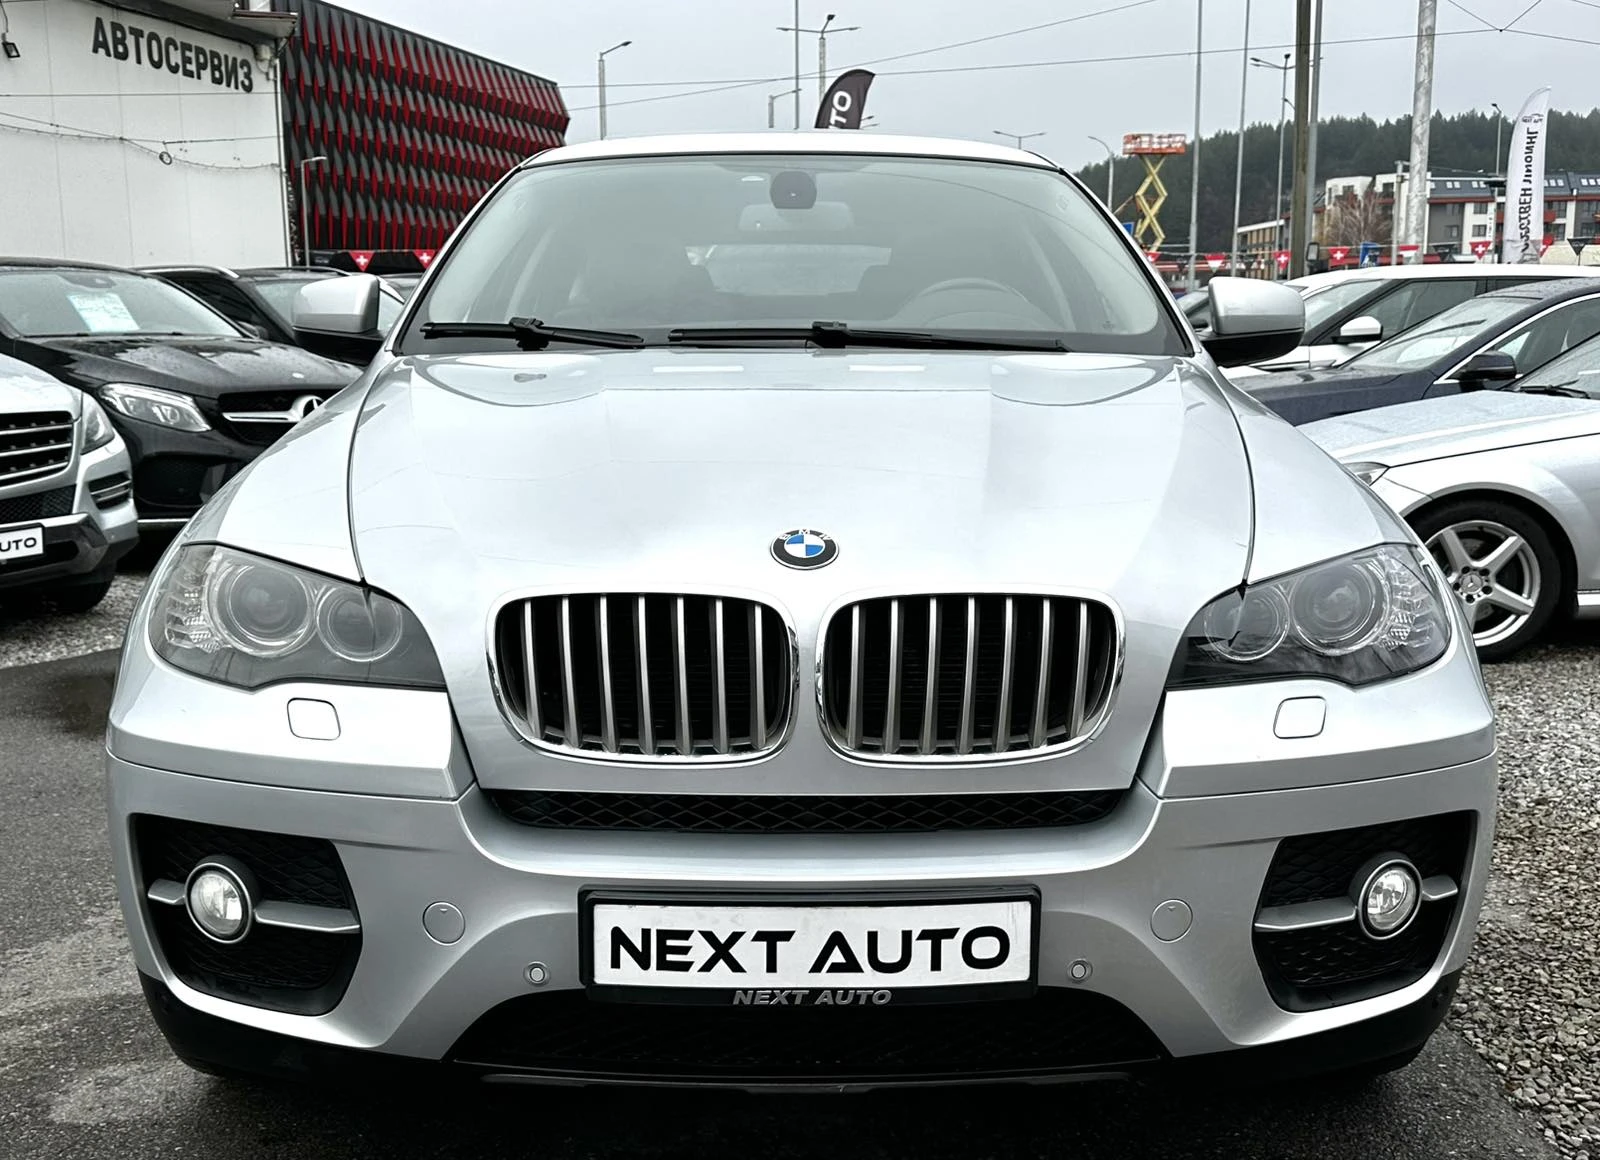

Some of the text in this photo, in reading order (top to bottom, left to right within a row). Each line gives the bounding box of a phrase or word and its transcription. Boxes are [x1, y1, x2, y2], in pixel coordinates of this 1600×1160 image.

[91, 16, 254, 94] АВТОСЕРВИЗ
[829, 90, 852, 128] TO
[610, 926, 1010, 974] NEXT AUTO
[733, 990, 892, 1006] NEXT AUTO
